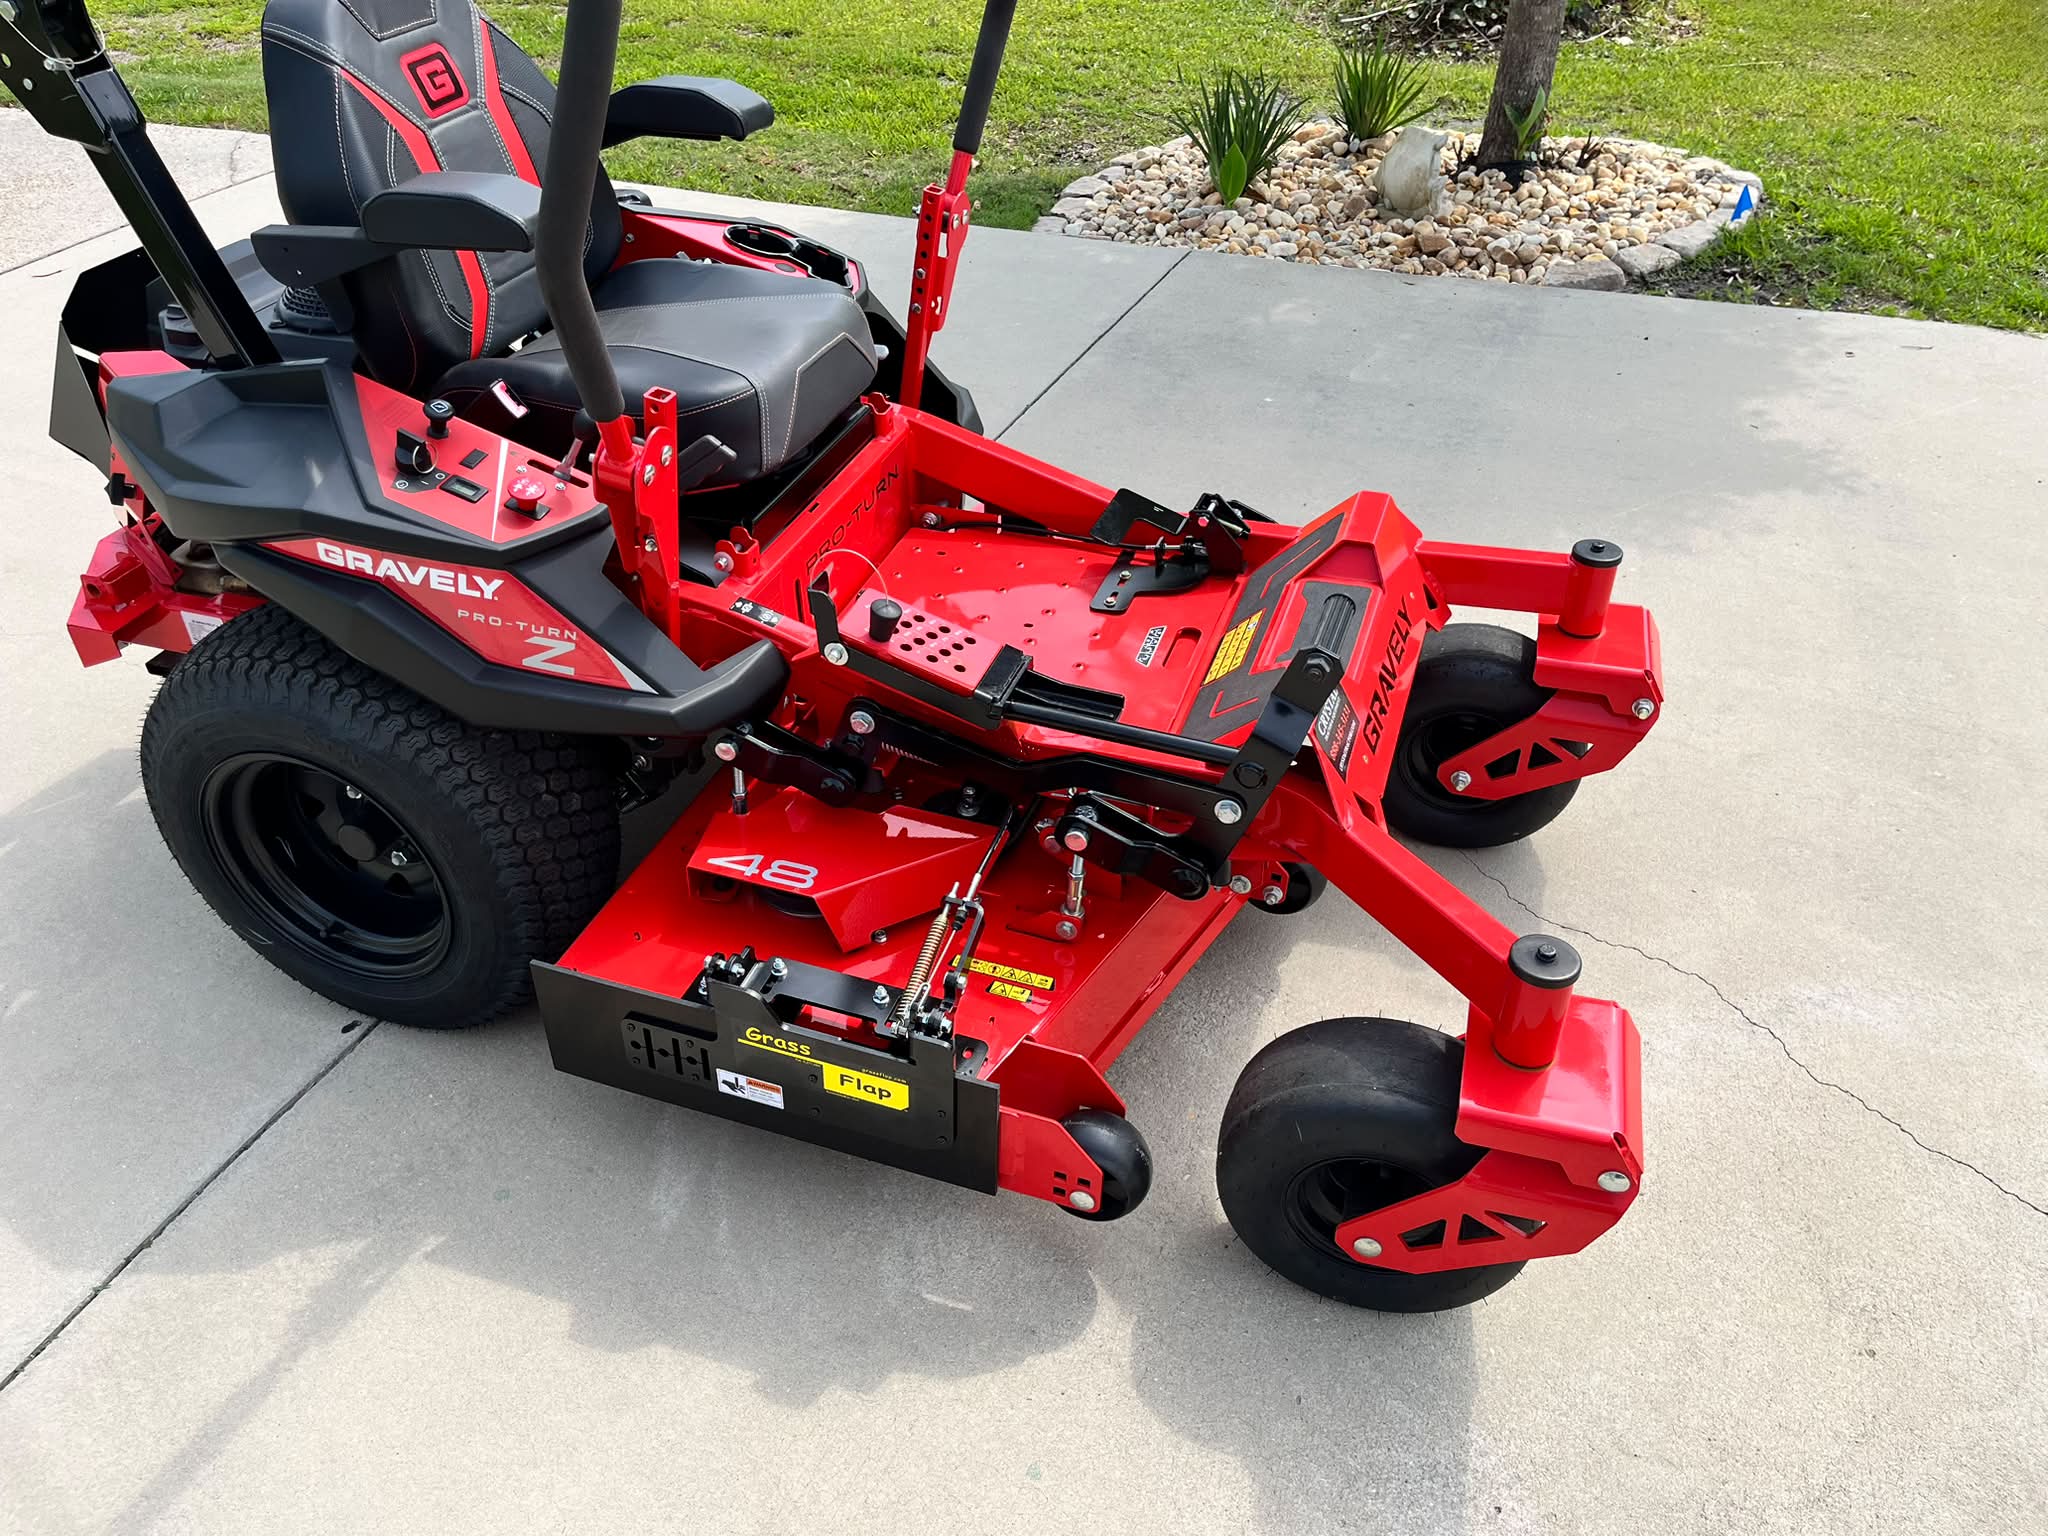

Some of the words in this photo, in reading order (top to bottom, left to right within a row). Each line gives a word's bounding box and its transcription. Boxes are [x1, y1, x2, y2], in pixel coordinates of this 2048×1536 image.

[806, 463, 900, 577] PRO-TURN
[316, 541, 504, 600] GRAVELY
[457, 608, 578, 641] PRO-TURN
[521, 635, 577, 676] Z
[1362, 594, 1413, 757] GRAVELY
[1317, 688, 1339, 736] CRYSTAL
[706, 853, 819, 889] 48
[745, 1026, 812, 1056] Grass
[839, 1073, 893, 1101] Flap
